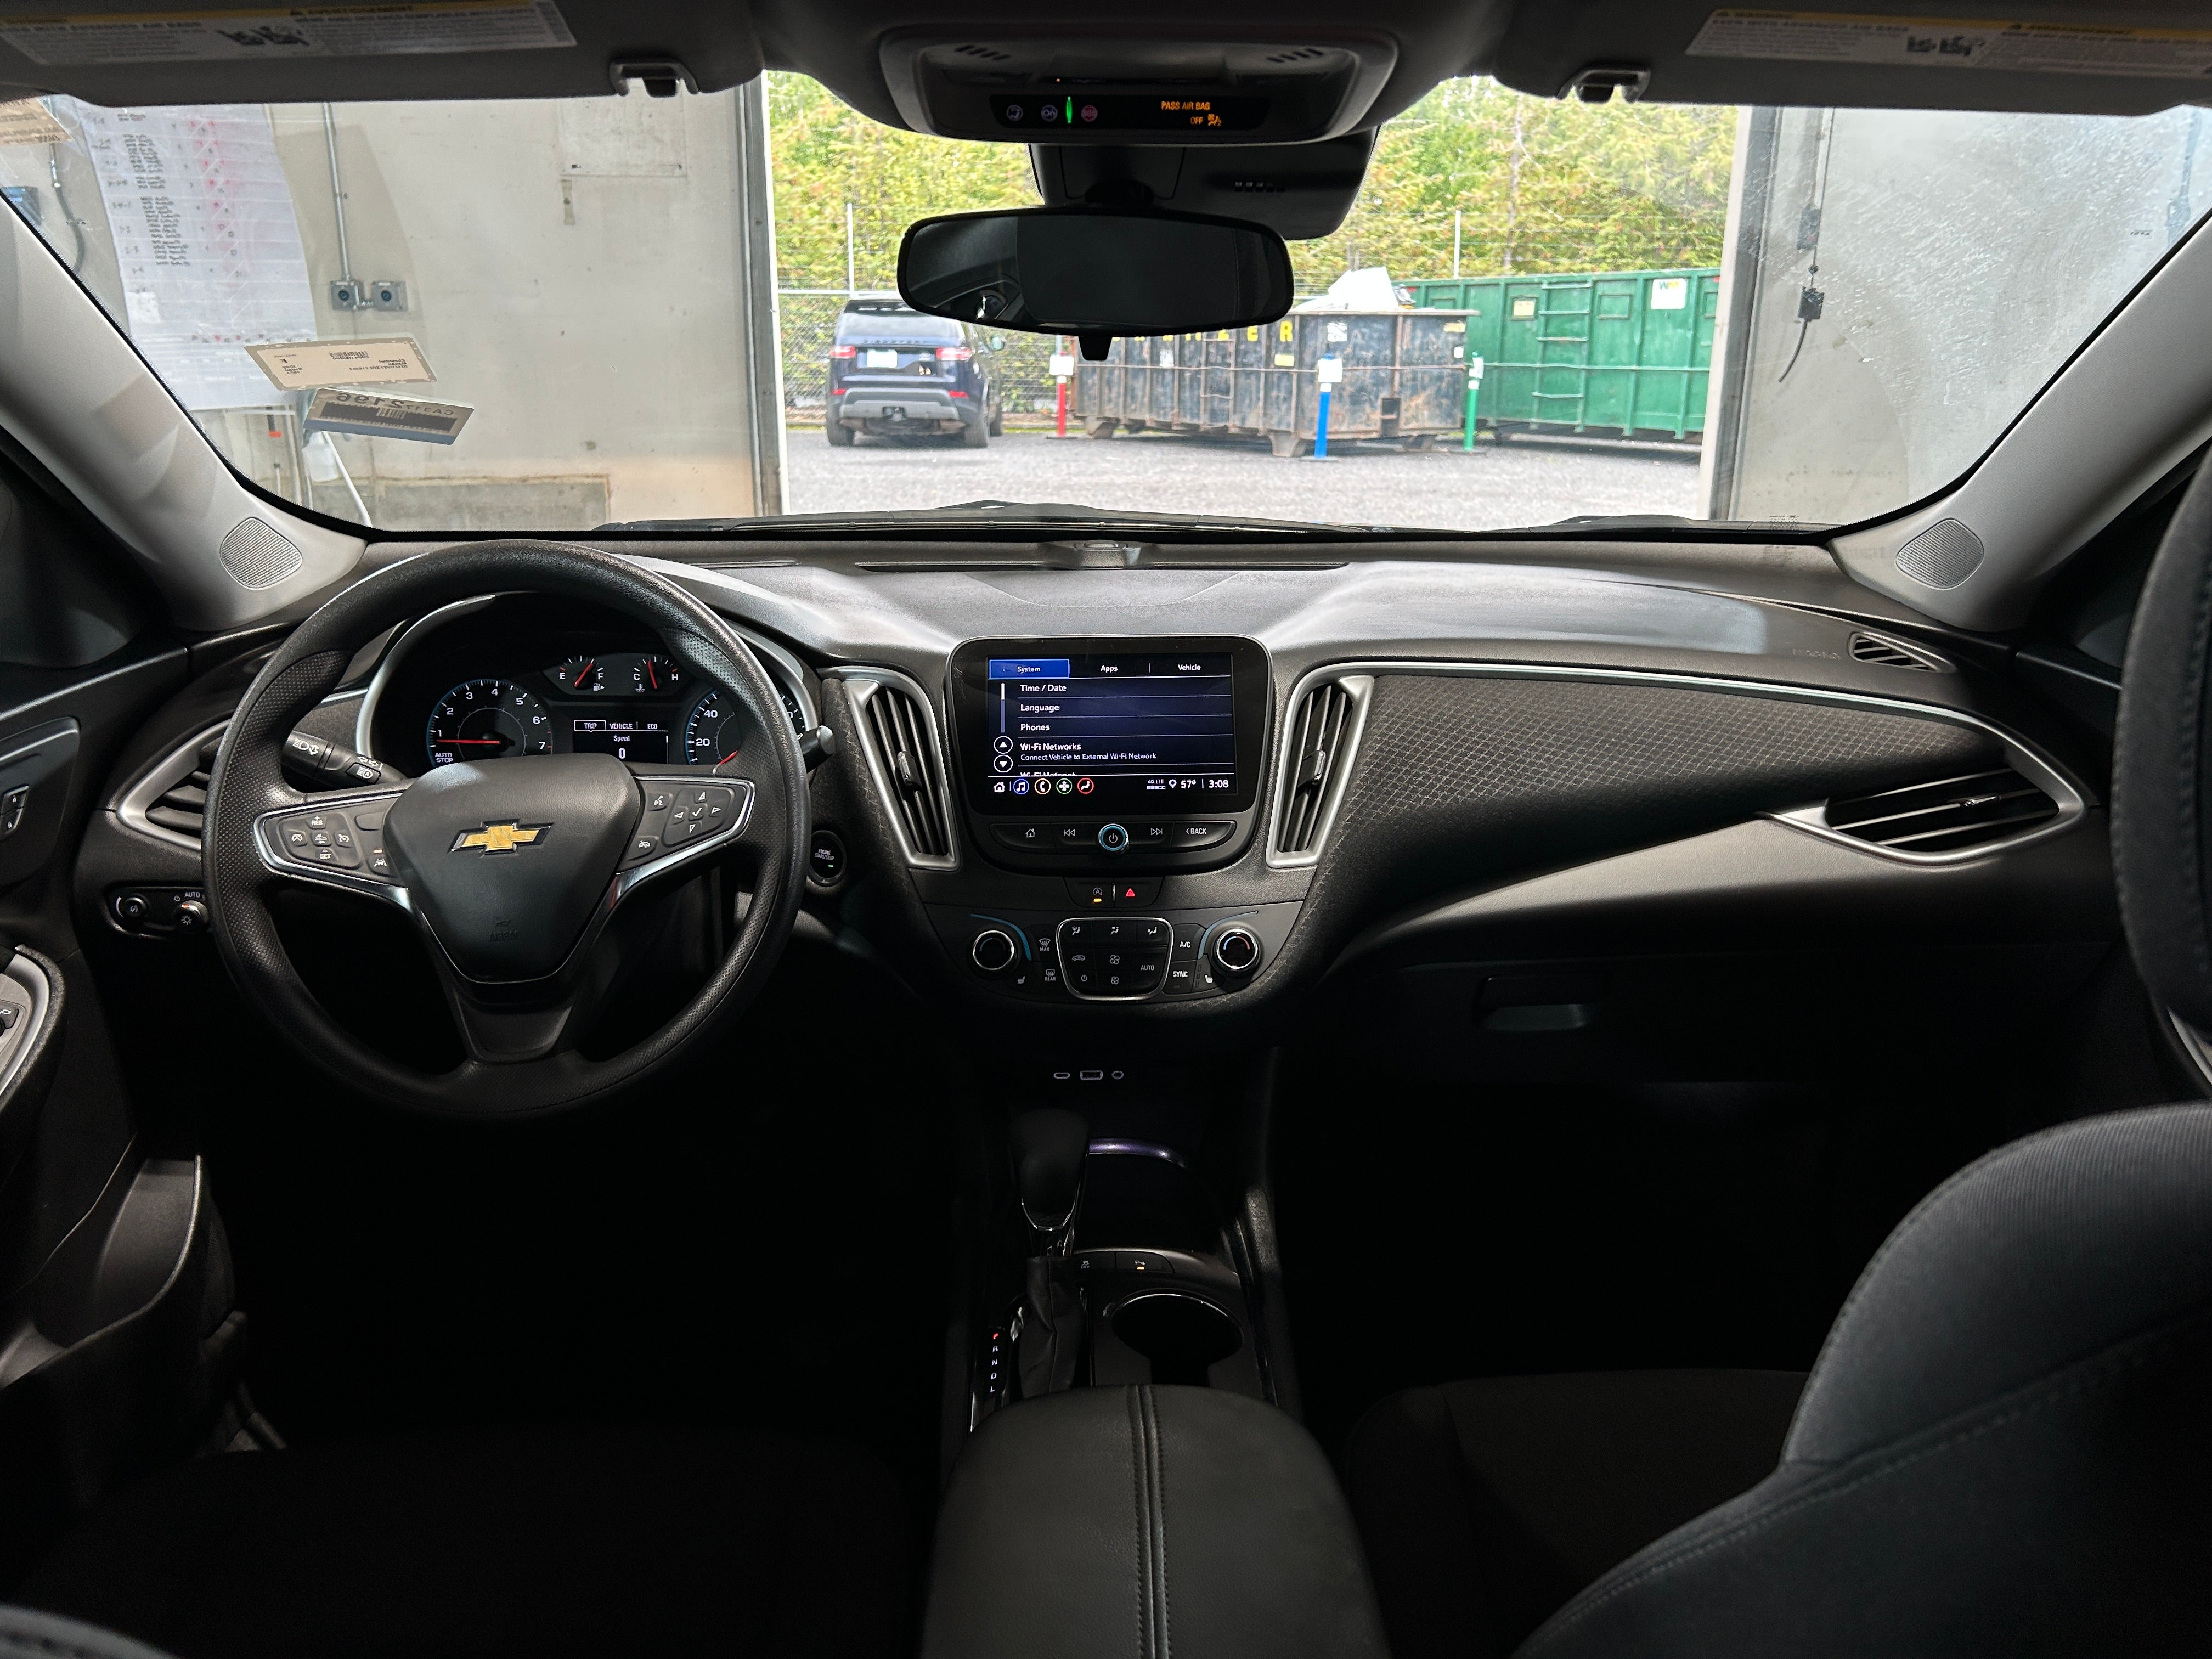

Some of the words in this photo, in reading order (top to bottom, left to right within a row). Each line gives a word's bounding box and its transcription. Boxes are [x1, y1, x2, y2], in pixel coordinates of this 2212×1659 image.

[1161, 101, 1180, 110] PASS
[1182, 101, 1194, 110] AIR
[1195, 101, 1211, 110] BAG
[1190, 116, 1204, 125] OFF
[1017, 665, 1041, 674] System
[1100, 664, 1118, 673] Apps
[466, 692, 473, 700] 3
[491, 688, 499, 696] 4
[516, 697, 523, 706] 5
[446, 707, 454, 715] 2
[1020, 704, 1060, 712] Language
[703, 709, 719, 718] 40
[532, 716, 540, 725] 6
[1020, 723, 1051, 731] Phones
[613, 735, 630, 743] Speed
[696, 738, 710, 747] 20
[538, 741, 546, 749] 7
[1020, 743, 1042, 751] Wi-Fi
[1043, 742, 1082, 751] Networks
[618, 747, 626, 759] 0
[1209, 779, 1229, 788] 3:08
[1172, 970, 1188, 979] SYNC
